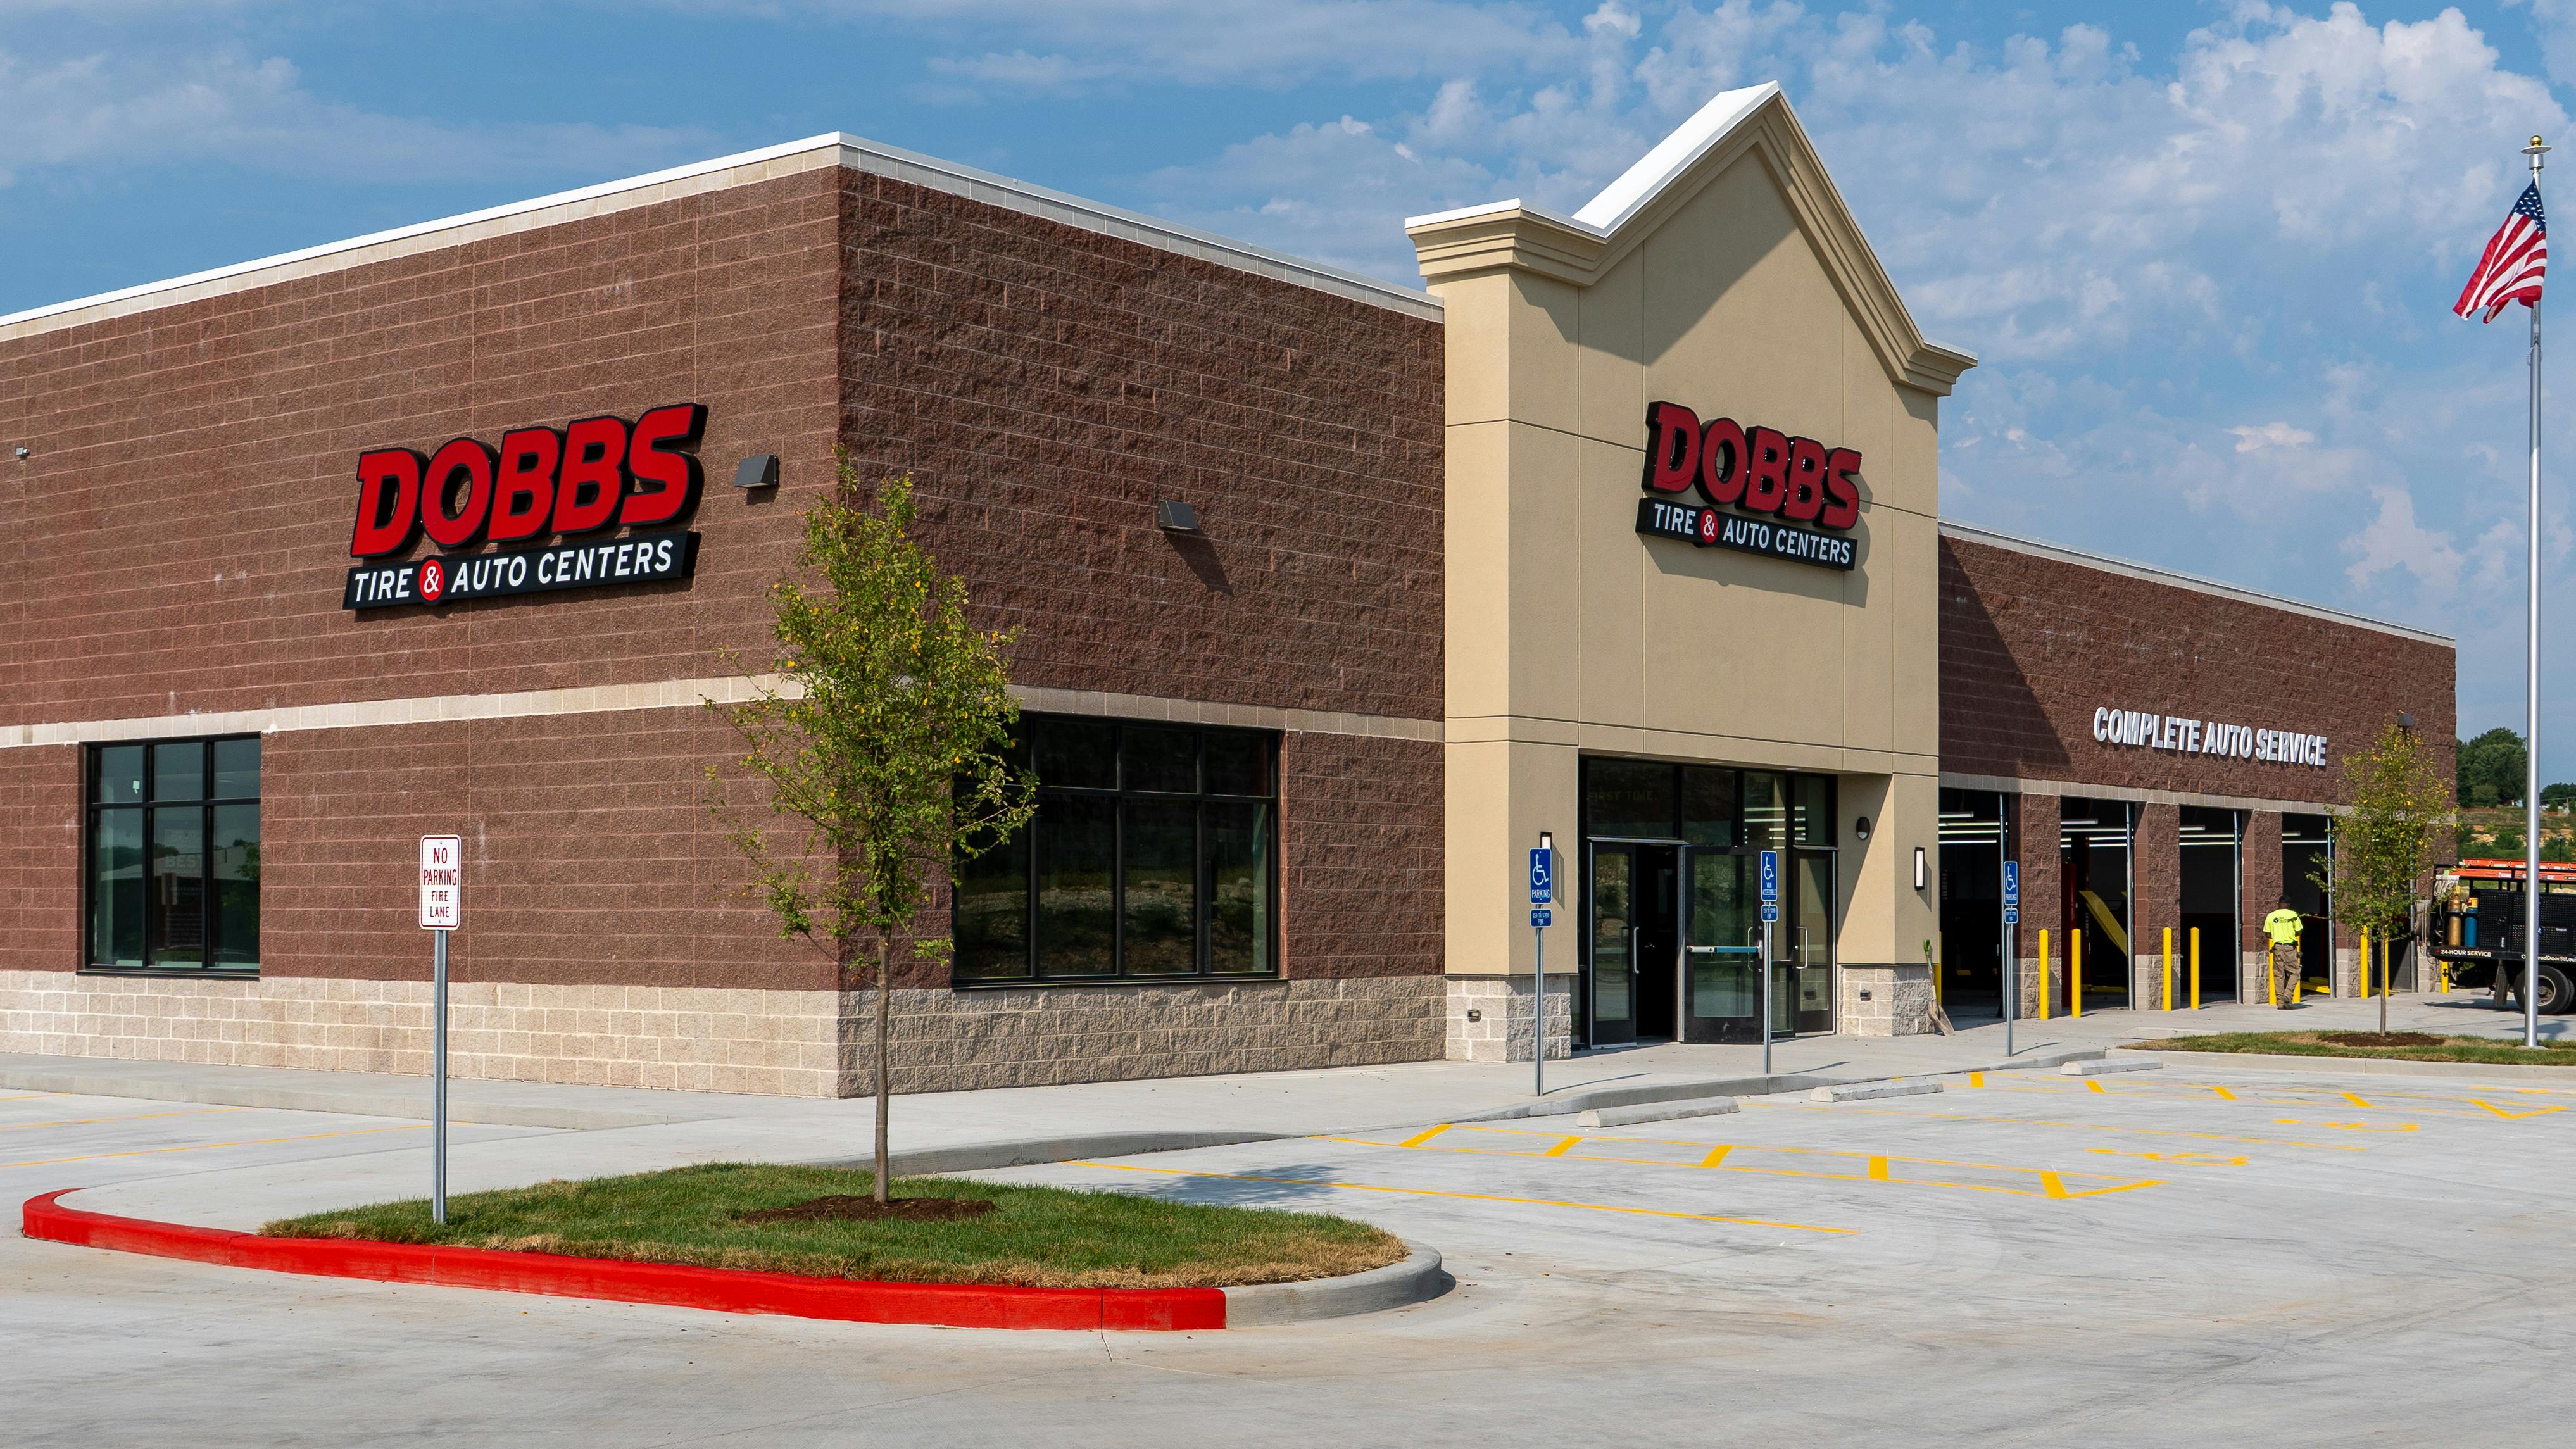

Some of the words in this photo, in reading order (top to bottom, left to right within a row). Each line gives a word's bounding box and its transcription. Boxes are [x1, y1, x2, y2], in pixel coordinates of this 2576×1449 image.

[351, 403, 705, 558] DOBBS
[1641, 401, 1862, 530] DOBBS
[1654, 504, 1696, 534] TIRE
[1703, 515, 1716, 537] &
[1722, 518, 1769, 548] AUTO
[1776, 529, 1850, 564] CENTERS
[355, 568, 413, 602] TIRE
[424, 569, 440, 593] &
[451, 556, 527, 593] AUTO
[538, 539, 674, 584] CENTERS
[2093, 706, 2201, 752] COMPLETE
[2202, 722, 2253, 758] AUTO
[2255, 729, 2327, 766] SERVICE
[434, 847, 448, 863] NO
[423, 869, 456, 886] PARKING
[431, 891, 449, 901] FIRE
[1531, 889, 1550, 898] PARKING
[430, 906, 449, 917] LANE
